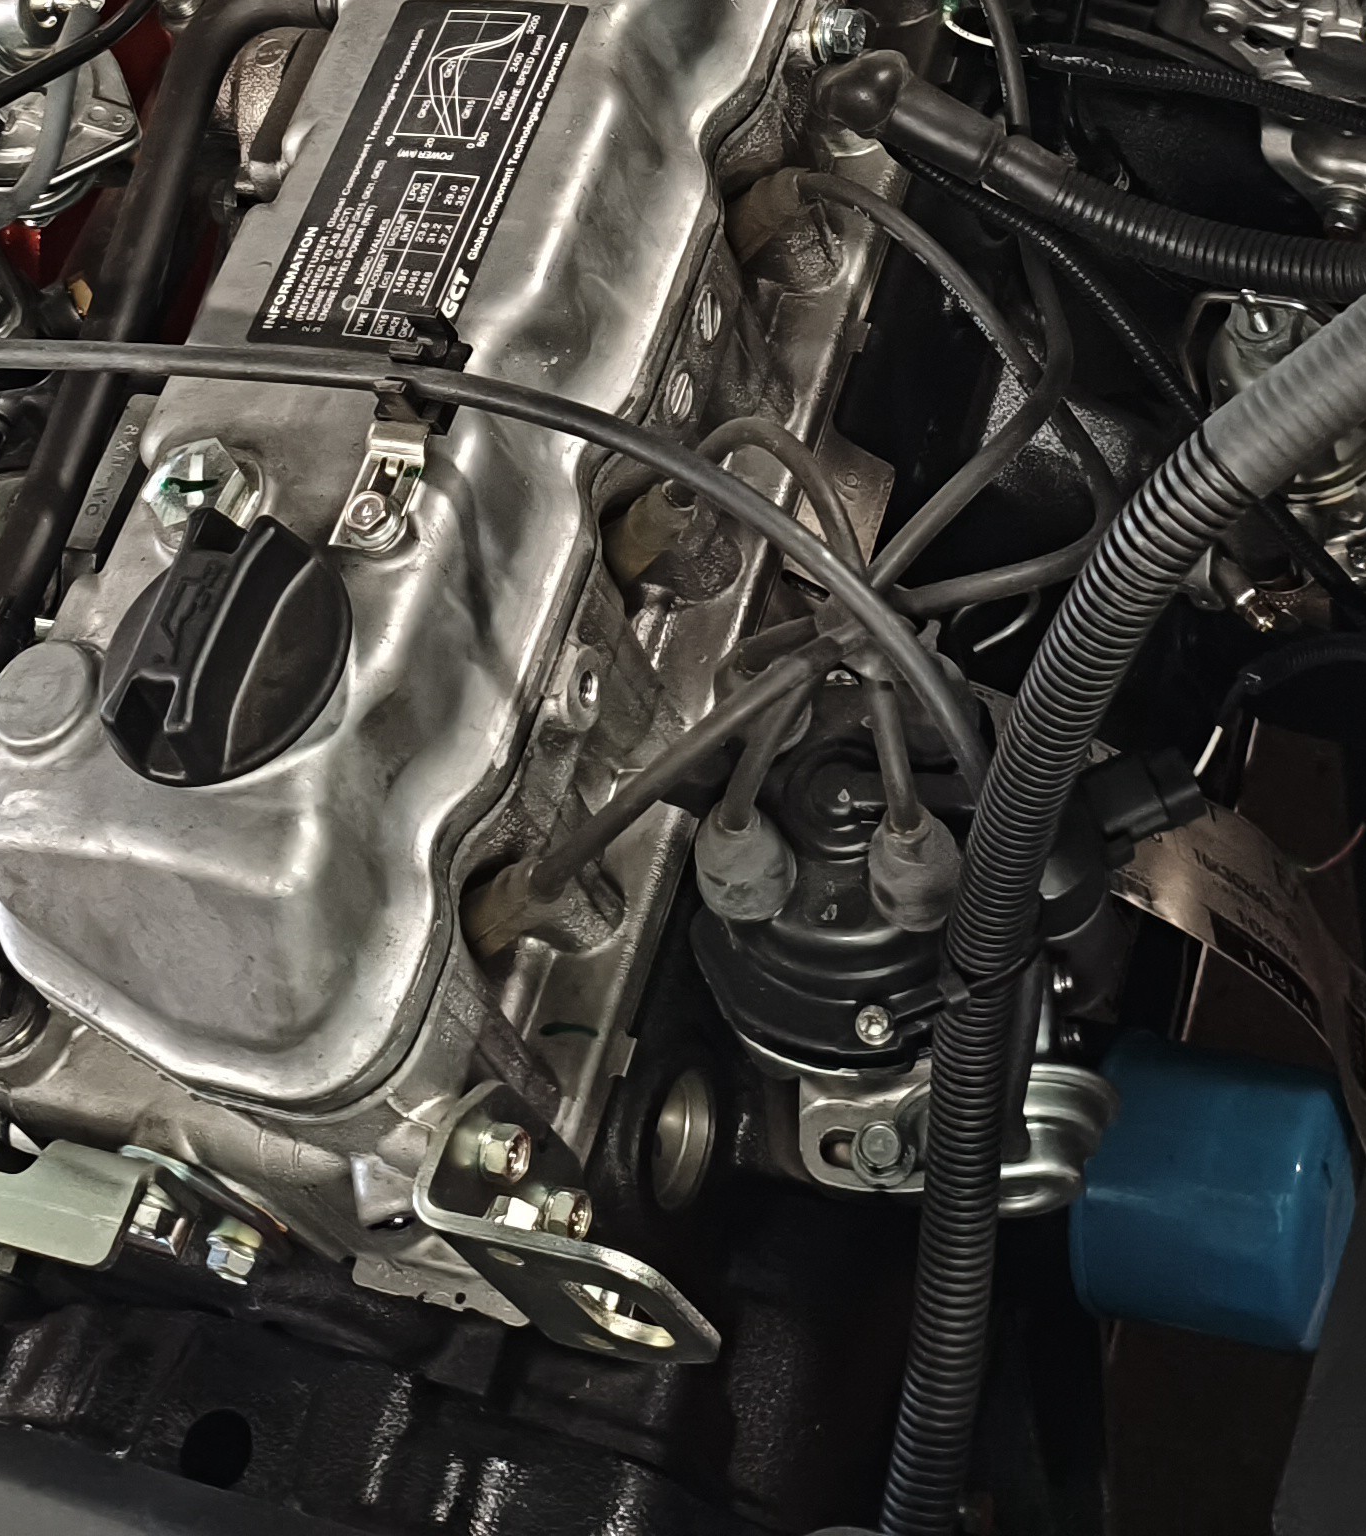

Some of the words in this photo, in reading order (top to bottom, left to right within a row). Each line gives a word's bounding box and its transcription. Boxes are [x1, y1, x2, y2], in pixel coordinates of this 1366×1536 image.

[475, 131, 490, 147] 800
[491, 90, 508, 110] 1600
[508, 52, 525, 72] 2400
[525, 14, 542, 34] 3200
[500, 87, 523, 120] ENGINE
[515, 56, 536, 85] SPEED
[528, 34, 547, 55] (rpm)
[383, 135, 396, 146] 40
[416, 149, 455, 161] POWER
[423, 137, 436, 148] 20
[465, 226, 490, 260] Global
[480, 166, 518, 225] Component
[506, 100, 546, 165] Technologies
[534, 42, 570, 99] Corporation
[284, 235, 329, 318] MANUFACTURER
[326, 197, 347, 227] Global
[340, 143, 373, 195] Component
[366, 82, 401, 140] Technologies
[394, 28, 425, 80] Corporation
[406, 181, 422, 201] LPG
[378, 270, 394, 288] (cc)
[398, 220, 417, 240] (kW)
[415, 182, 433, 202] (kW)
[386, 213, 408, 246] GASOLINE
[425, 222, 443, 243] 31.2
[442, 184, 459, 205] 29.0
[437, 224, 454, 244] 37.4
[454, 185, 471, 206] 35.0
[261, 225, 319, 329] INFORMATION
[294, 264, 327, 320] (REFERRED
[320, 248, 334, 261] TO
[328, 232, 342, 245] AS
[335, 206, 354, 230] GCT)
[316, 289, 339, 321] ENGINE
[332, 259, 352, 287] RATED
[345, 227, 366, 258] POWER
[360, 204, 378, 226] (NET)
[353, 255, 374, 284] BASIC
[367, 218, 391, 254] VALUES
[359, 252, 391, 305] DISPLACEMENT
[305, 288, 328, 320] ENGINE
[321, 265, 338, 286] TYPE
[353, 311, 370, 331] TYPE
[436, 266, 476, 319] GCT
